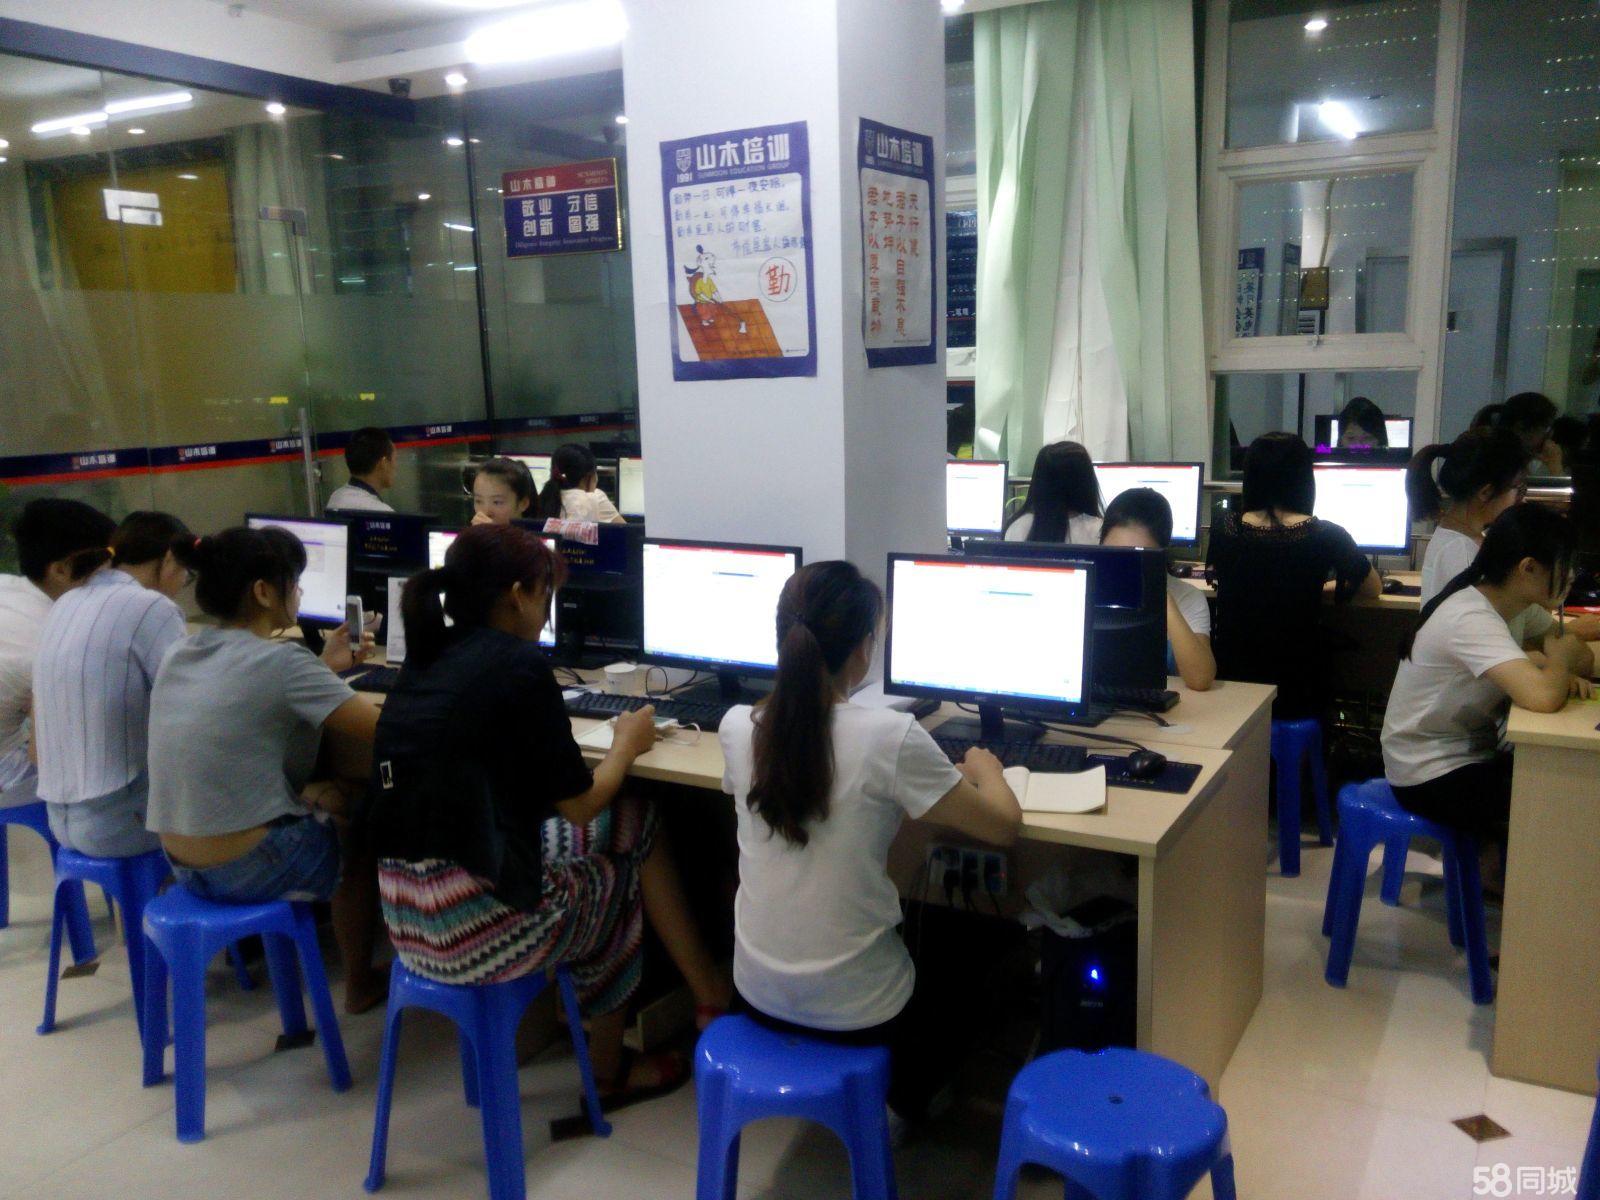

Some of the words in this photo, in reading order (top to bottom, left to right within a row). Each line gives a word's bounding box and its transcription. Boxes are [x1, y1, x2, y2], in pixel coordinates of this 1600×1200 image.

[696, 134, 790, 171] 山木培训
[877, 131, 924, 167] 山木培训
[521, 198, 552, 217] 敬业
[567, 193, 599, 213] 守信
[523, 218, 554, 237] 创新
